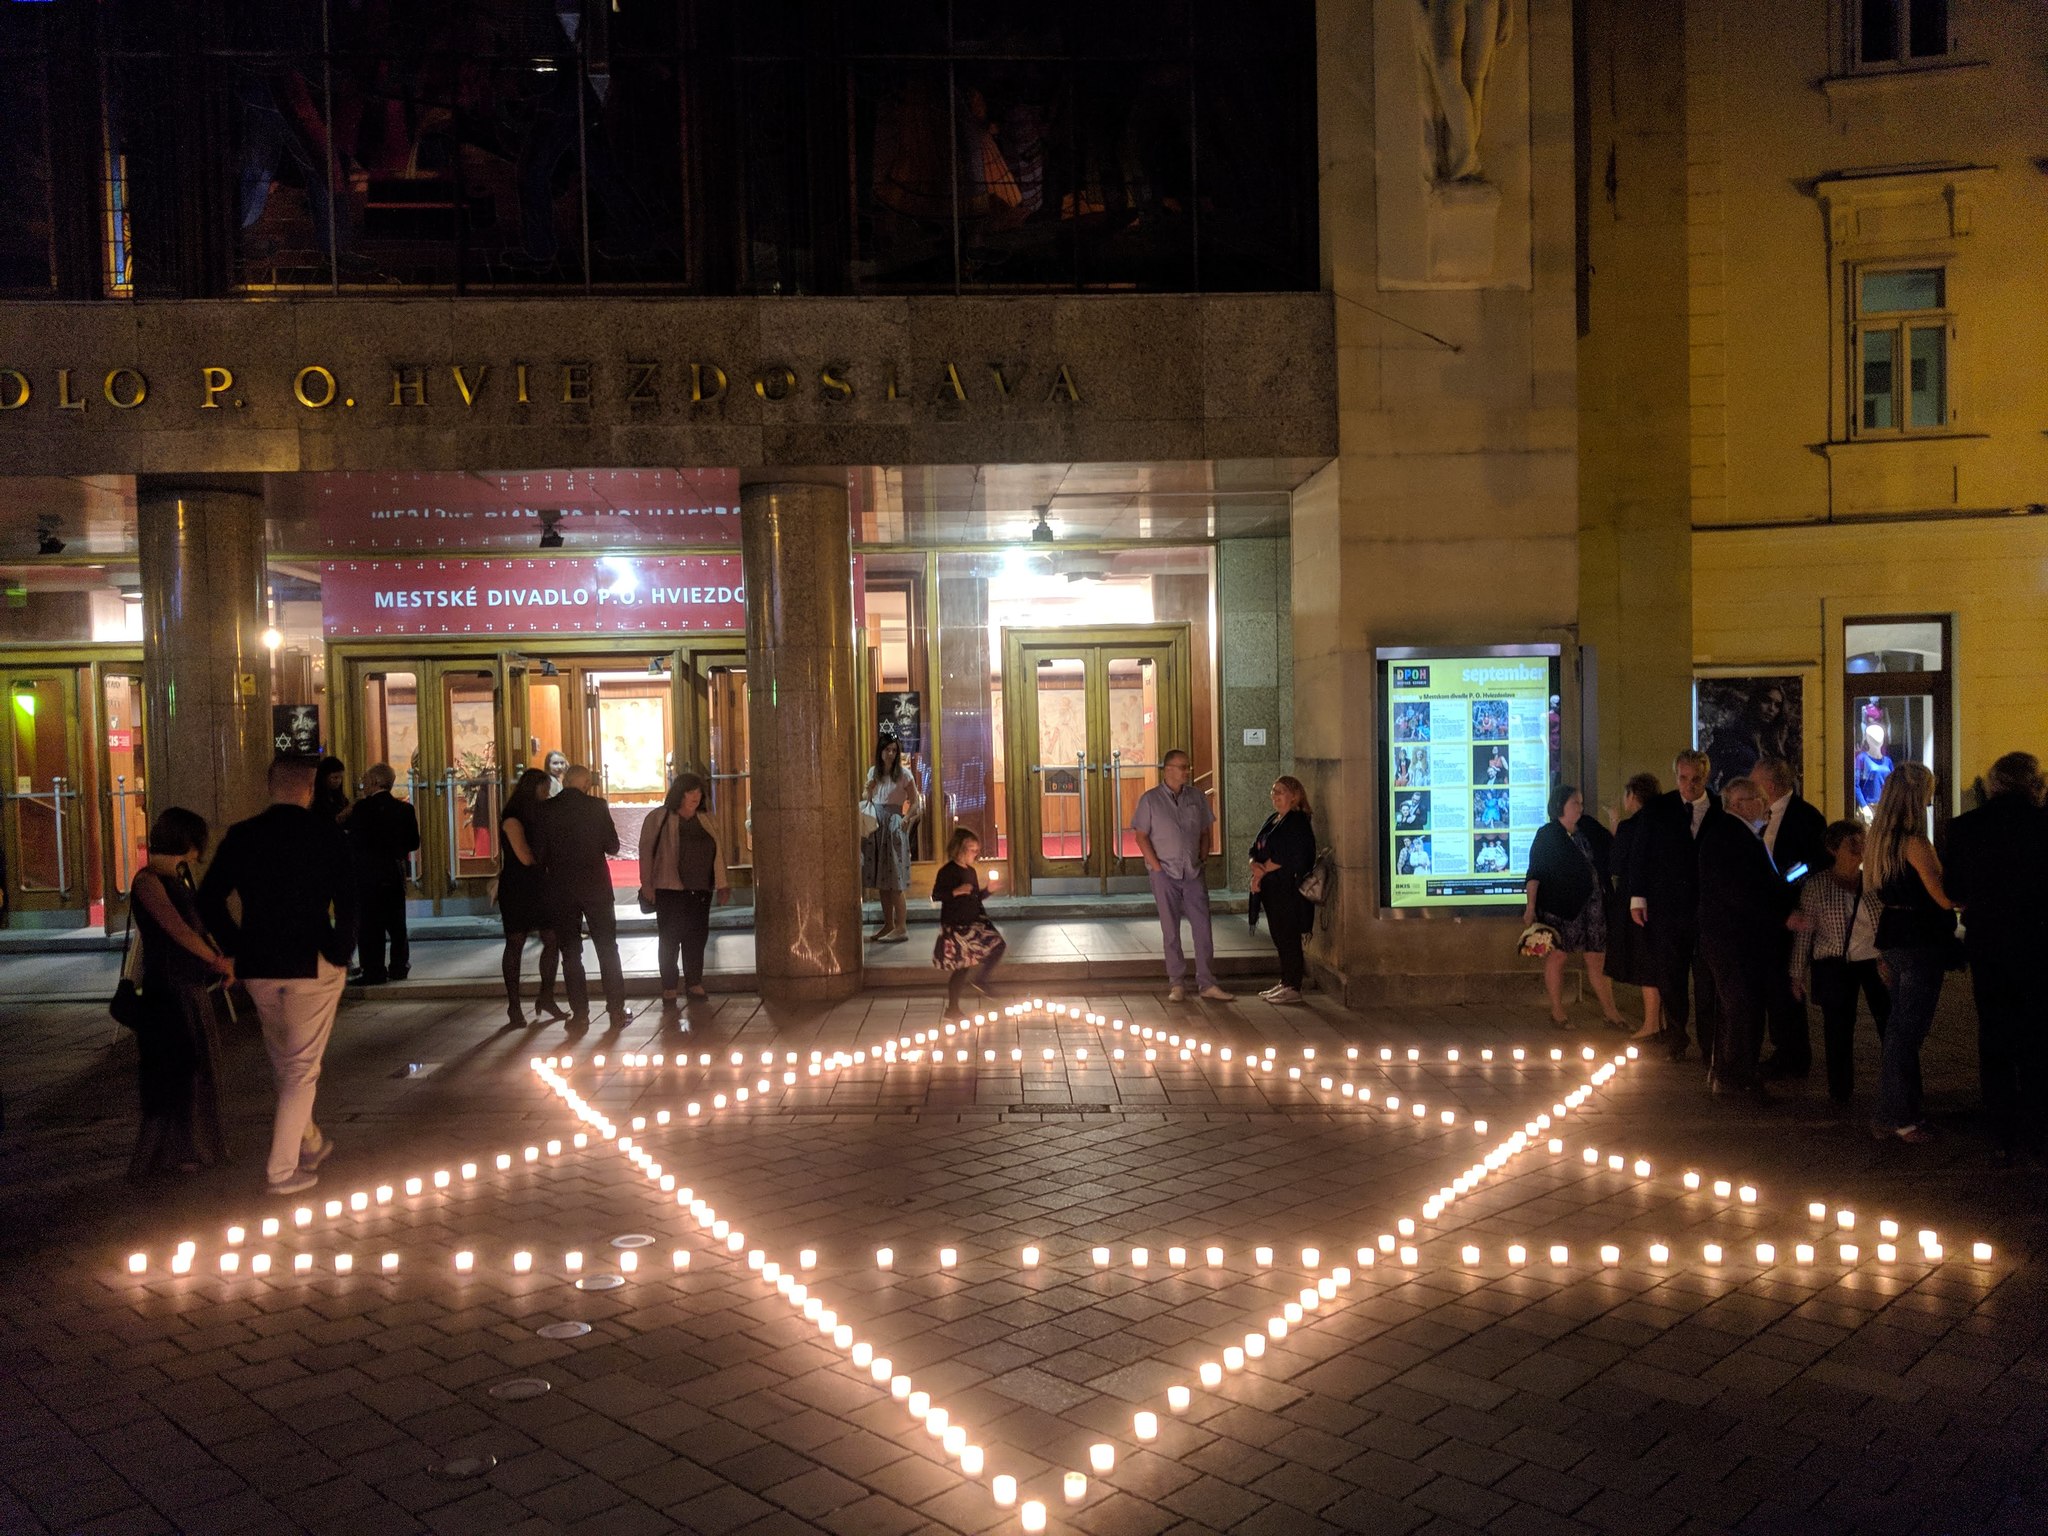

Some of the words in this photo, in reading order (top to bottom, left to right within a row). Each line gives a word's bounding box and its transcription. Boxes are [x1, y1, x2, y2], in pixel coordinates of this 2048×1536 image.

[0, 369, 147, 411] DLO
[201, 367, 247, 408] P.
[294, 365, 354, 408] O.
[390, 362, 1081, 407] HVIEZDOSLAVA
[375, 586, 478, 608] MESTSKÉ
[488, 588, 589, 606] DIVADLO
[1397, 668, 1427, 681] DPOH
[1463, 664, 1546, 685] september
